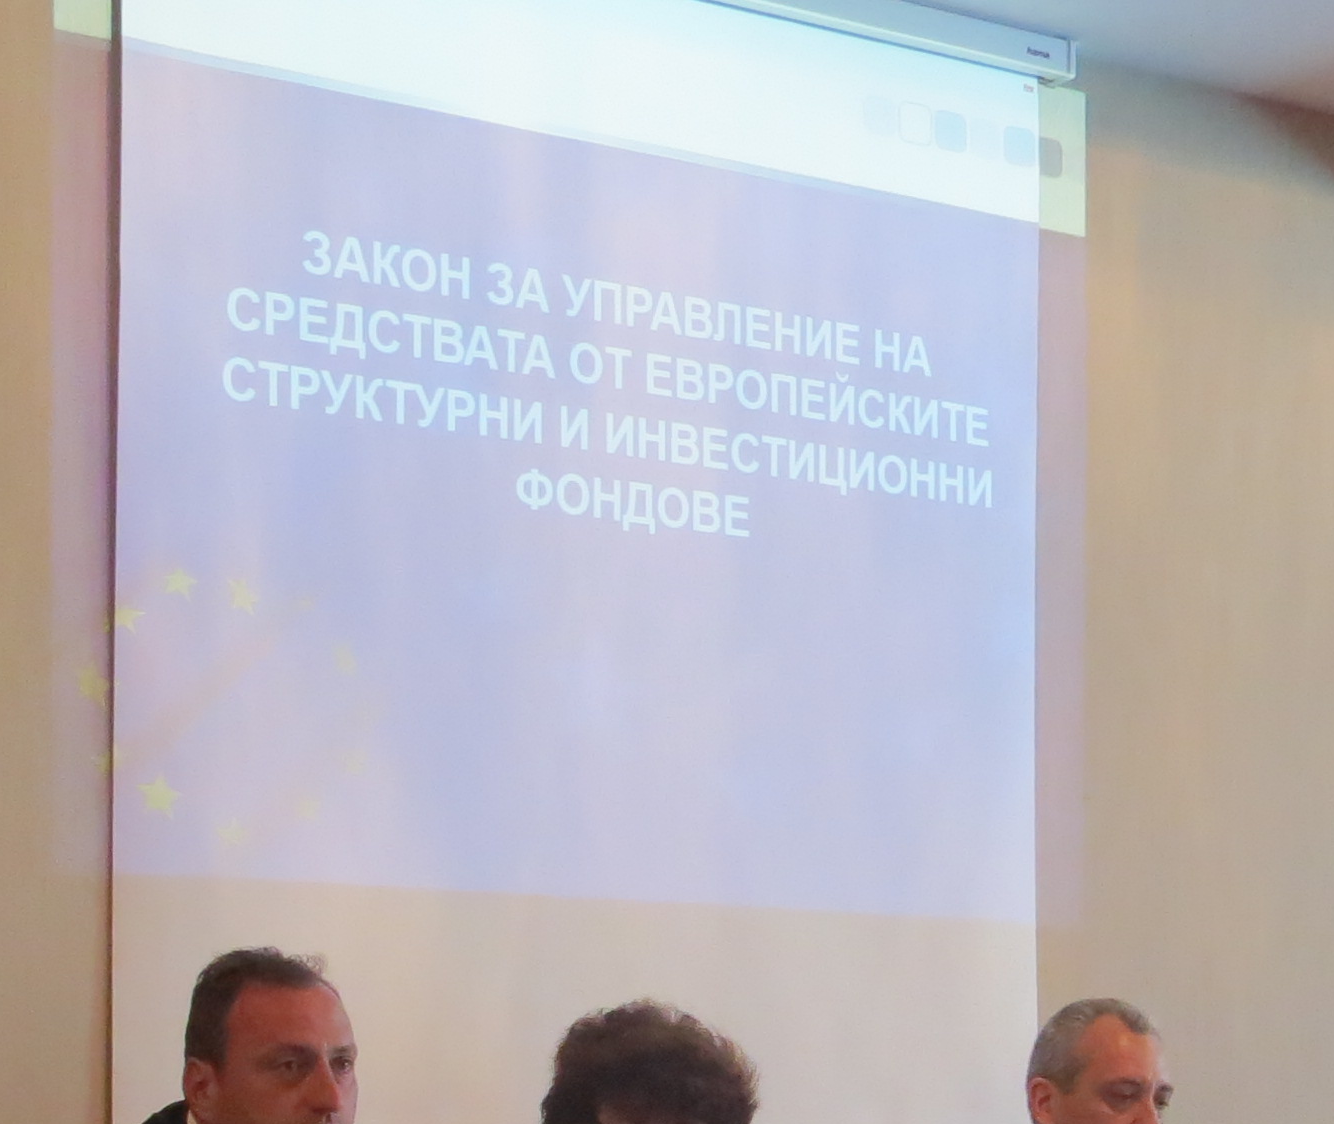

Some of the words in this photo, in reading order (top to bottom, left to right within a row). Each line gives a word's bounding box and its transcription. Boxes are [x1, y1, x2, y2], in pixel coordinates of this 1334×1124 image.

[227, 287, 556, 379] СРЕДСТВАТА
[569, 342, 632, 390] ОТ
[646, 352, 989, 447] ЕВРОПЕЙСКИТЕ
[302, 230, 471, 300] ЗАКОН
[486, 262, 549, 314] ЗА
[562, 273, 860, 366] УПРАВЛЕНИЕ
[875, 328, 932, 377] НА
[222, 356, 543, 444] СТРУКТУРНИ
[560, 405, 588, 450] И
[605, 411, 993, 508] ИНВЕСТИЦИОННИ
[516, 468, 750, 538] ФОНДОВЕ
